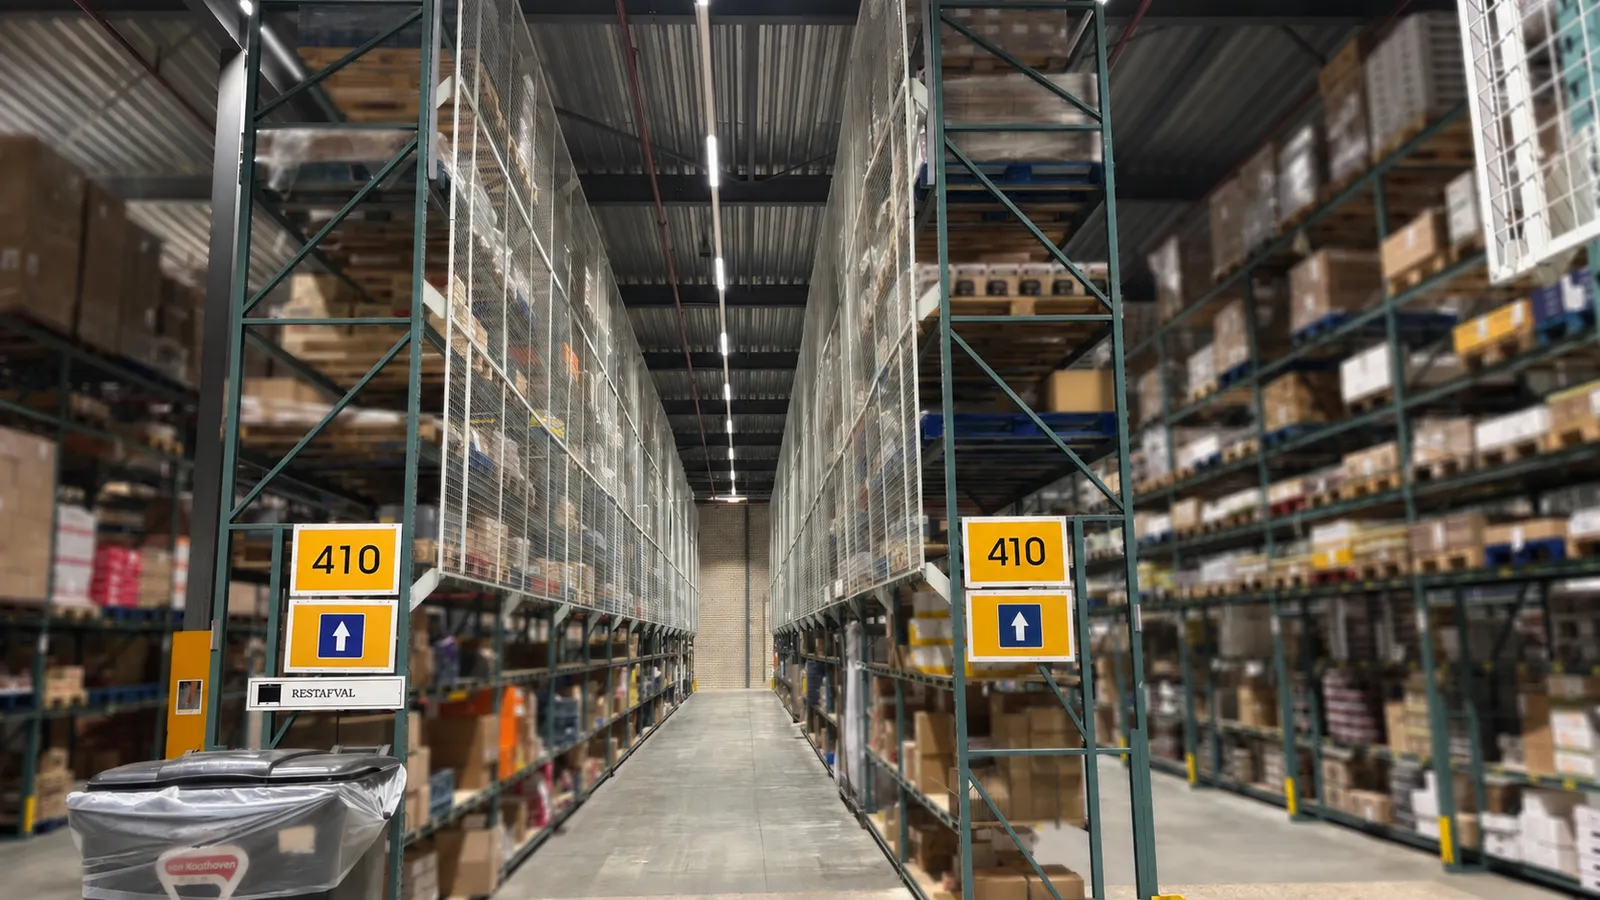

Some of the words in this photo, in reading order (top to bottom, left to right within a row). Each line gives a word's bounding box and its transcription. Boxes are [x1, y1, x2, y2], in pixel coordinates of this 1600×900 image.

[312, 545, 380, 575] 410
[987, 536, 1047, 566] 410
[291, 688, 356, 699] RESTAFVAL
